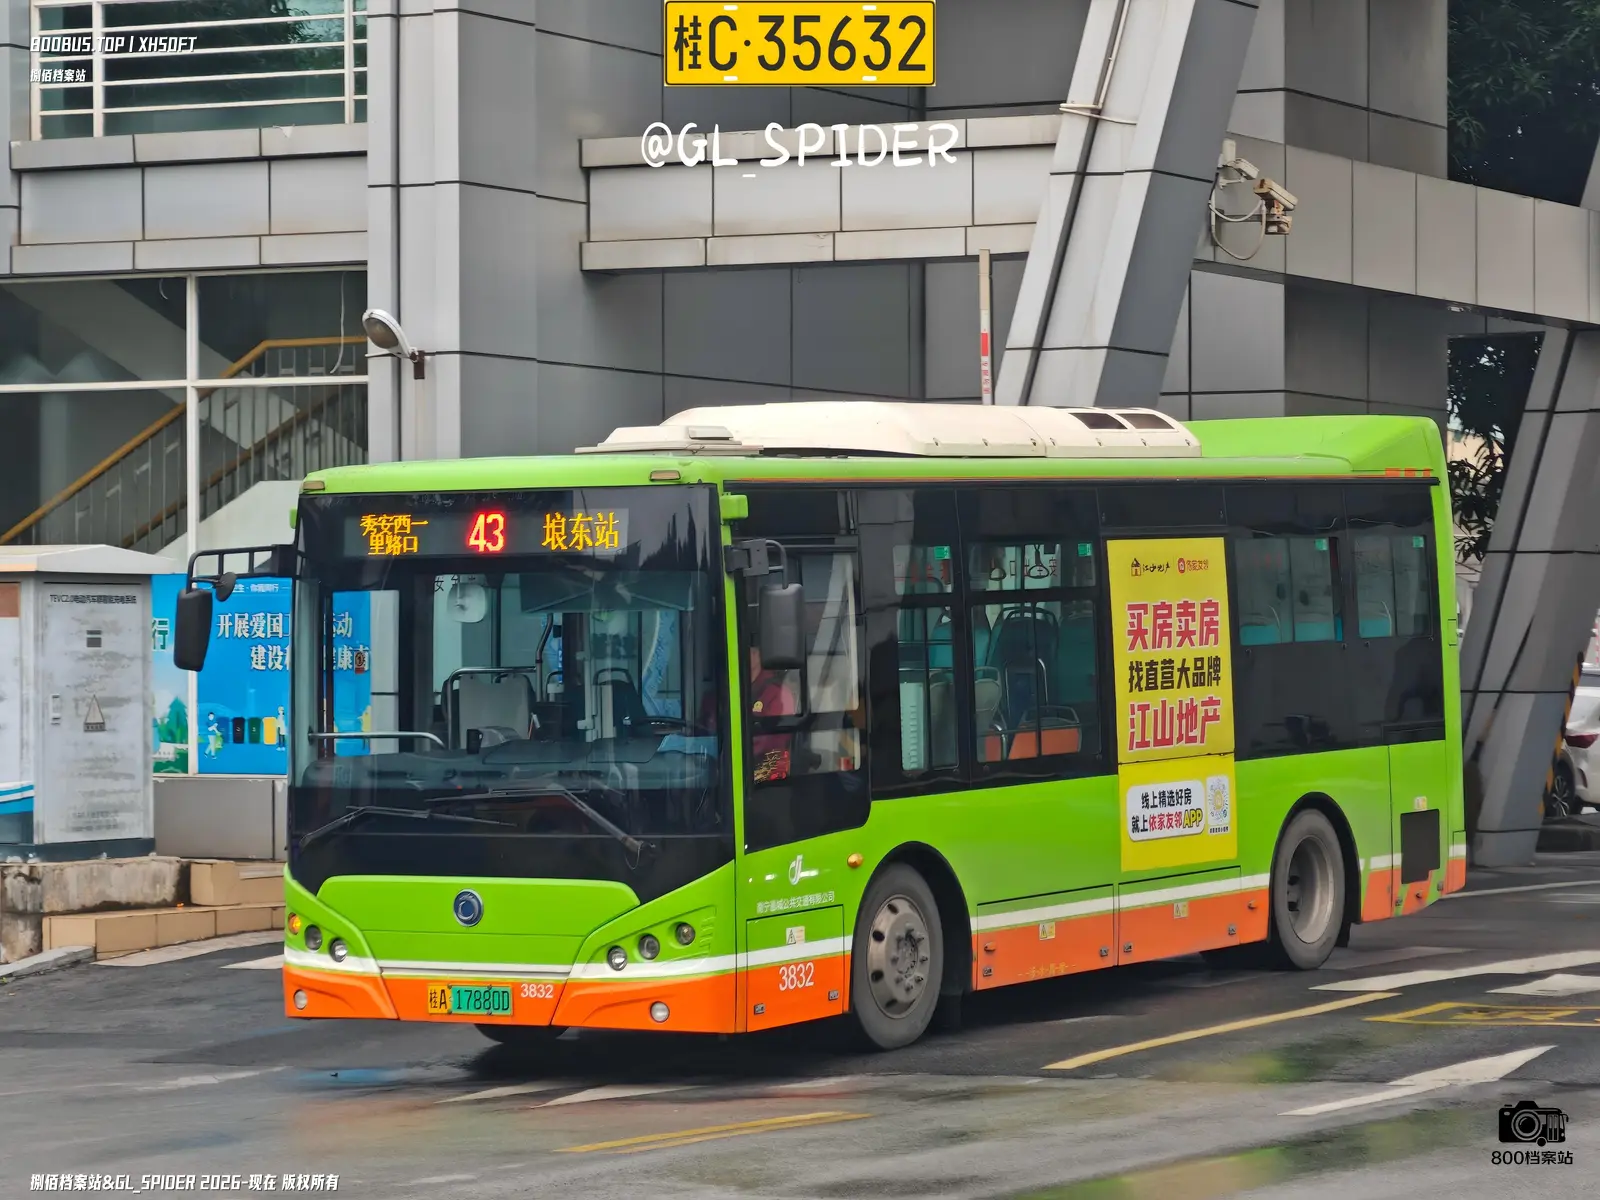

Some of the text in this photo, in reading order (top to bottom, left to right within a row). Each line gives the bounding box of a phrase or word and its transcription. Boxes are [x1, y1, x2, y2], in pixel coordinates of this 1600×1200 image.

[468, 513, 504, 551] 43
[542, 512, 619, 550] 埌东站
[1126, 599, 1220, 652] 买房卖房
[1128, 656, 1221, 693] 找直营大品牌
[1128, 696, 1222, 751] 江山地产
[1141, 788, 1192, 809] 线上精选好房
[1131, 808, 1204, 833] 就上依家友邻APP
[520, 983, 554, 998] 3832
[778, 961, 815, 992] 3832
